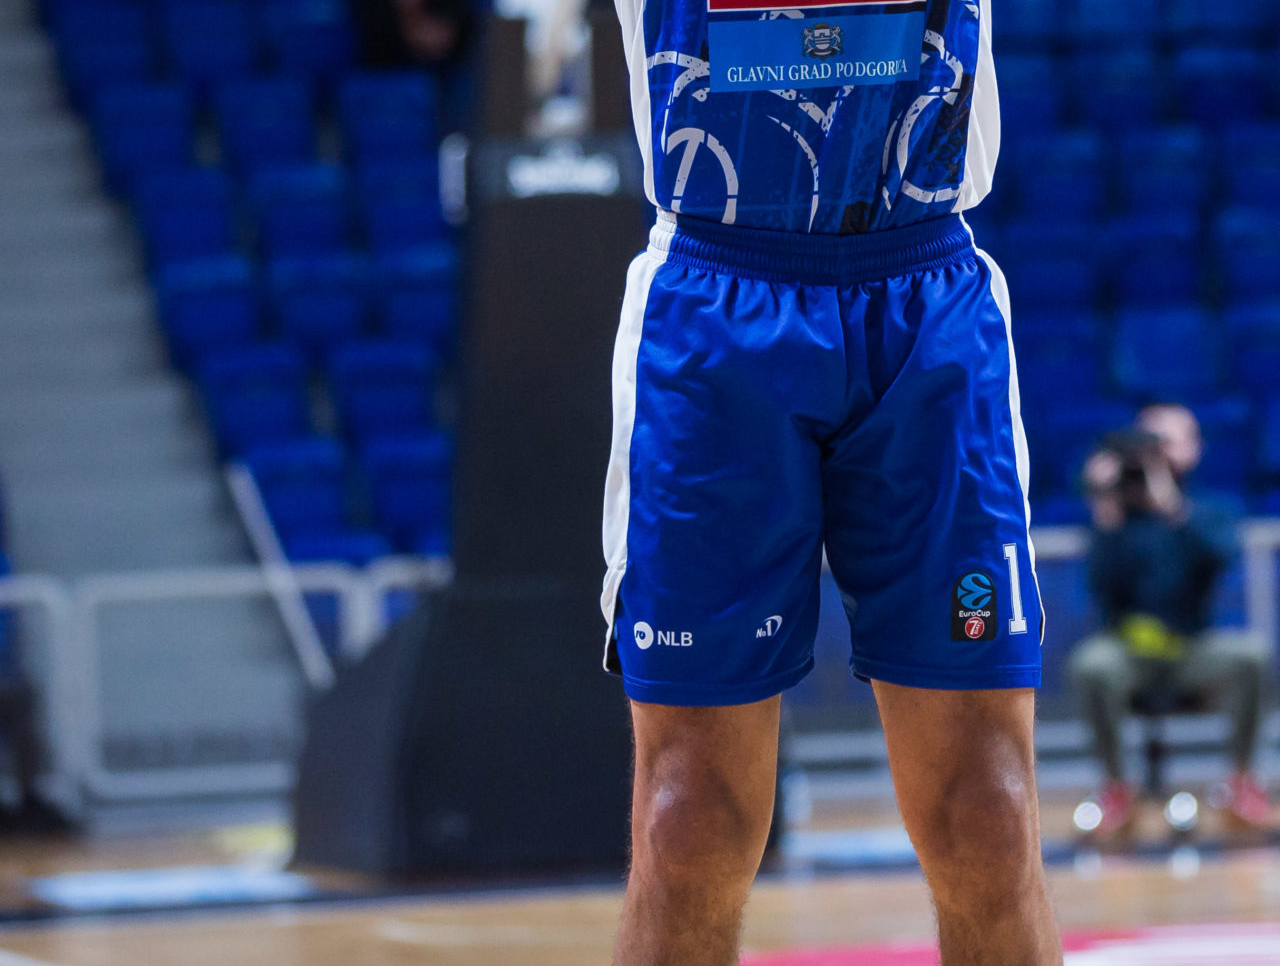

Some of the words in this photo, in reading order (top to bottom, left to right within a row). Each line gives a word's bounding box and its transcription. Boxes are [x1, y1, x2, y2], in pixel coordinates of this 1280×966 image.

[727, 65, 784, 83] GLAVNI
[788, 63, 831, 81] GRAD
[1002, 543, 1028, 635] 1
[959, 609, 991, 618] EuroCup
[657, 630, 693, 647] NLB
